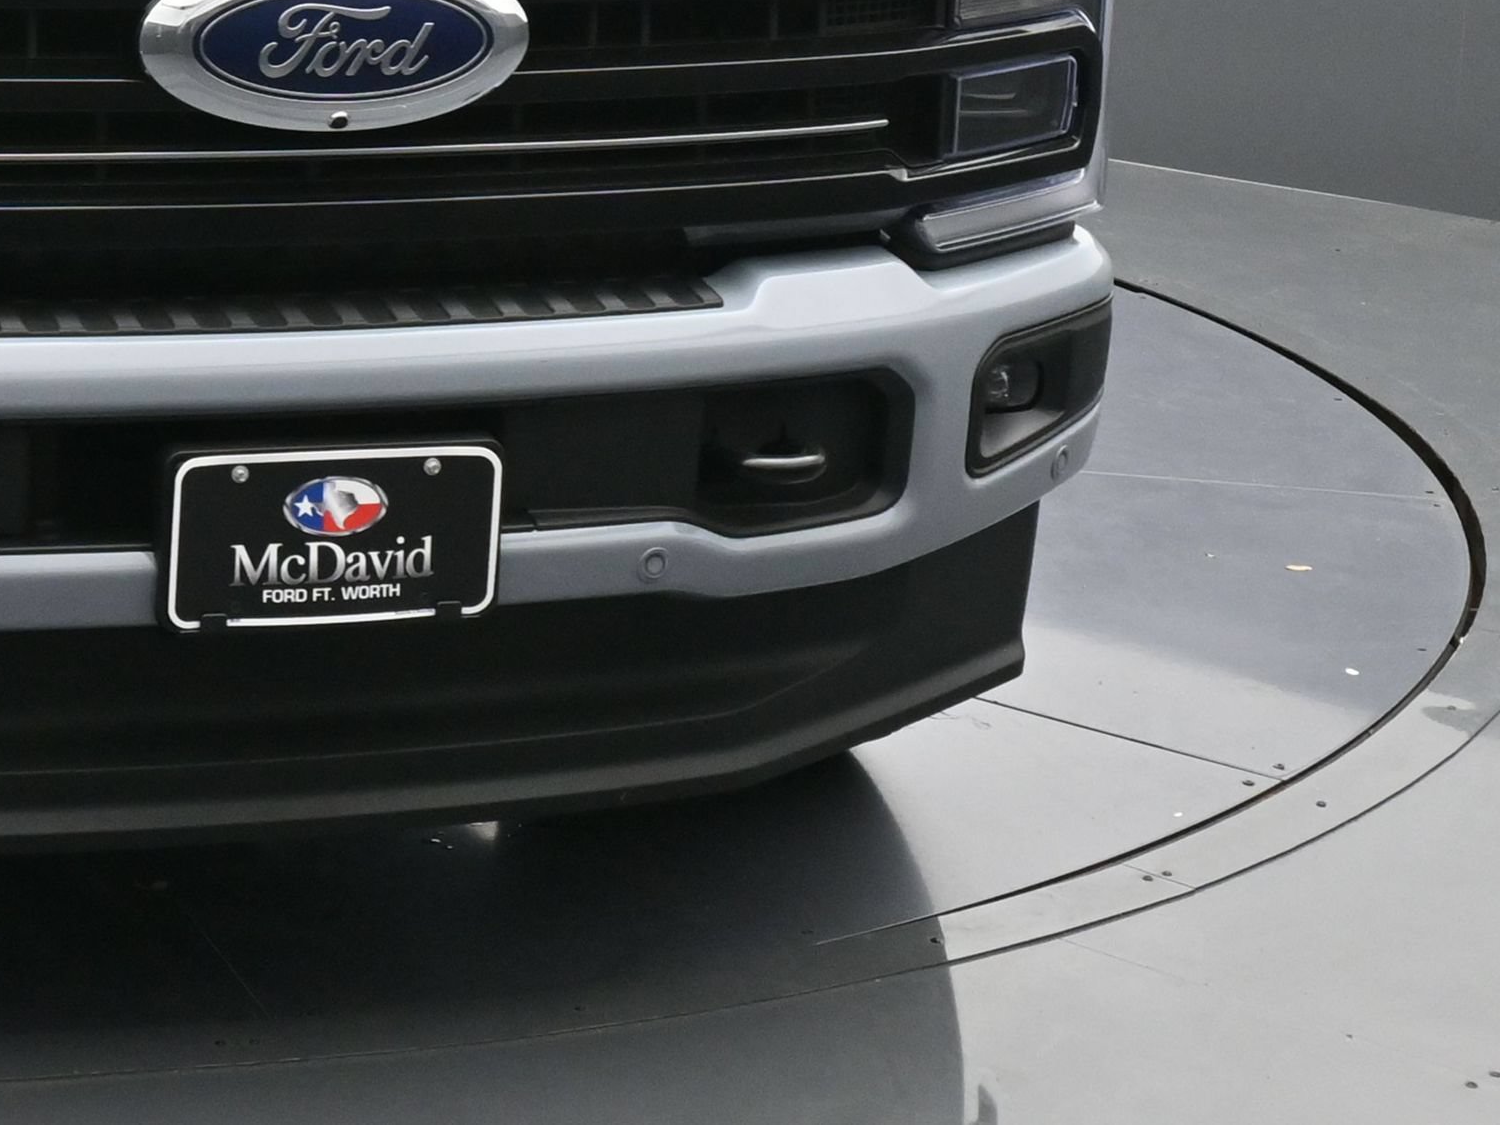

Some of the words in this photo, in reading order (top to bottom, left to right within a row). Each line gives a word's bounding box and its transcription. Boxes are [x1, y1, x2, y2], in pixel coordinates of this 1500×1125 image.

[258, 2, 436, 79] Ford
[229, 535, 434, 587] McDavid
[262, 588, 308, 604] FORD
[312, 587, 336, 602] FT.
[341, 583, 401, 600] WORTH
